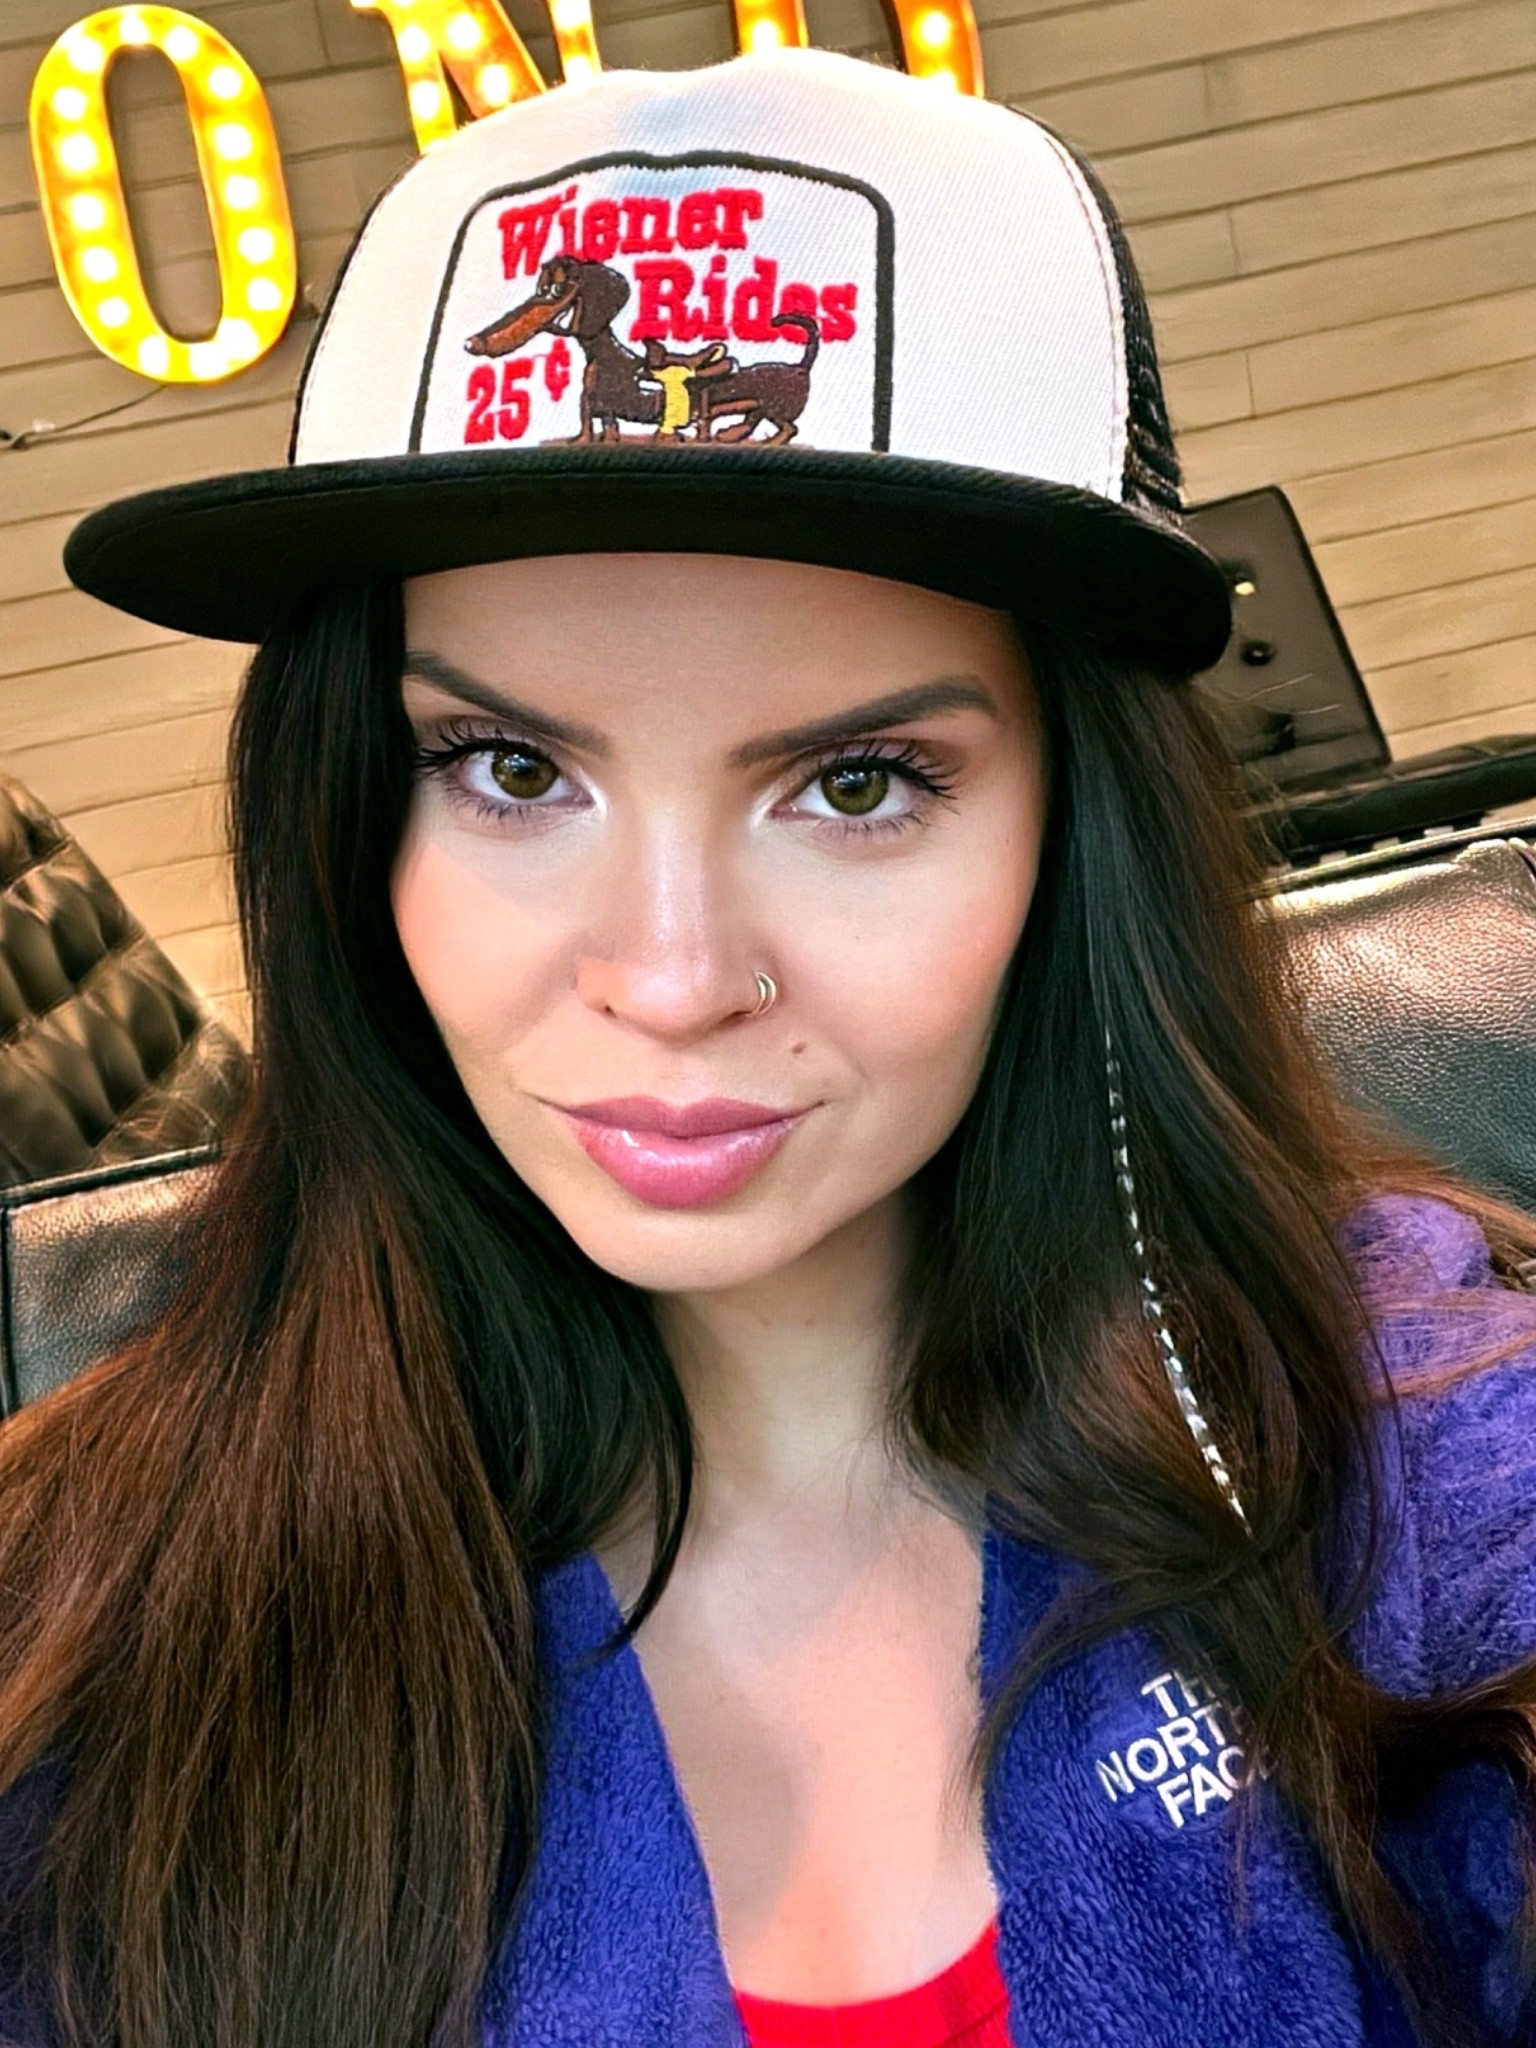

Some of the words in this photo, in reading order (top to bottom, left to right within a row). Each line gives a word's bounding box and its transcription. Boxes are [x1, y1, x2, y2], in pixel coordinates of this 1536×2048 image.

[498, 185, 763, 280] Wiener
[629, 255, 858, 343] Rides
[464, 338, 571, 445] 25¢
[1140, 1669, 1224, 1719] TH
